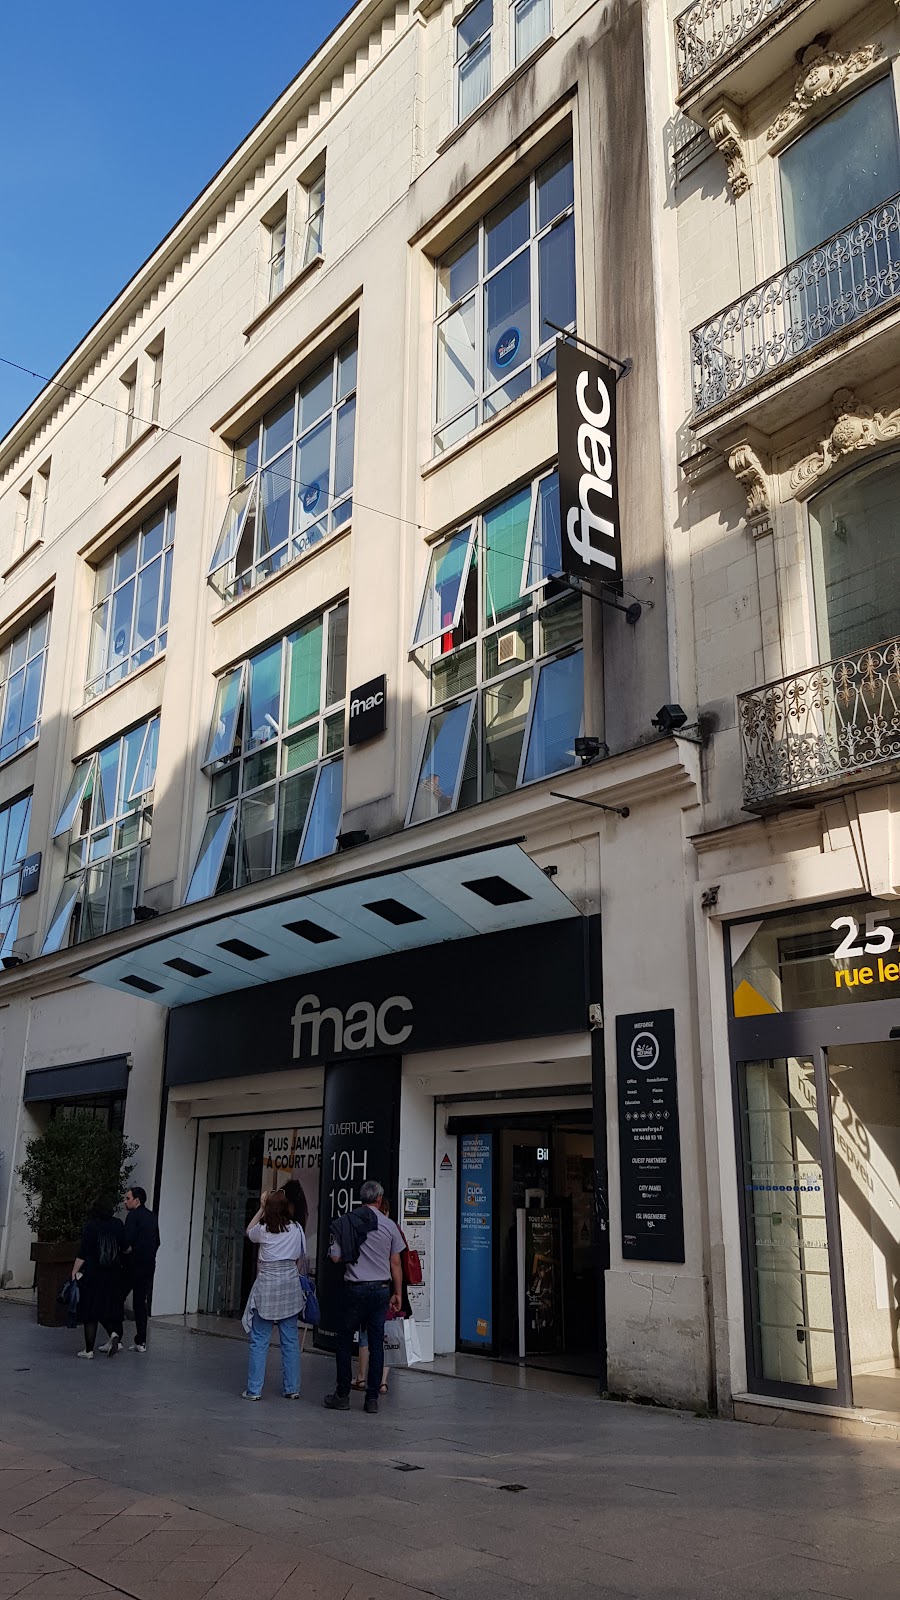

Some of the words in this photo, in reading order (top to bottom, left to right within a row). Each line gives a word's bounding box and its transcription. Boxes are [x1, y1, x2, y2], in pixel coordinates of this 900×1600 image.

[566, 370, 616, 571] fnac
[351, 691, 384, 718] fnac
[23, 863, 39, 877] fnac
[835, 966, 874, 987] rue
[878, 958, 900, 983] le
[290, 993, 413, 1059] fnac
[634, 1021, 654, 1029] WEFORGE
[329, 1121, 375, 1136] OUVERTURE
[631, 1125, 664, 1133] www.weforge.fr
[267, 1136, 289, 1151] PLUS
[266, 1152, 273, 1169] À
[275, 1154, 306, 1169] COURT
[537, 1148, 549, 1161] Bil
[330, 1149, 368, 1182] 10H
[467, 1187, 484, 1195] CLICK
[464, 1216, 476, 1224] PRÊTS
